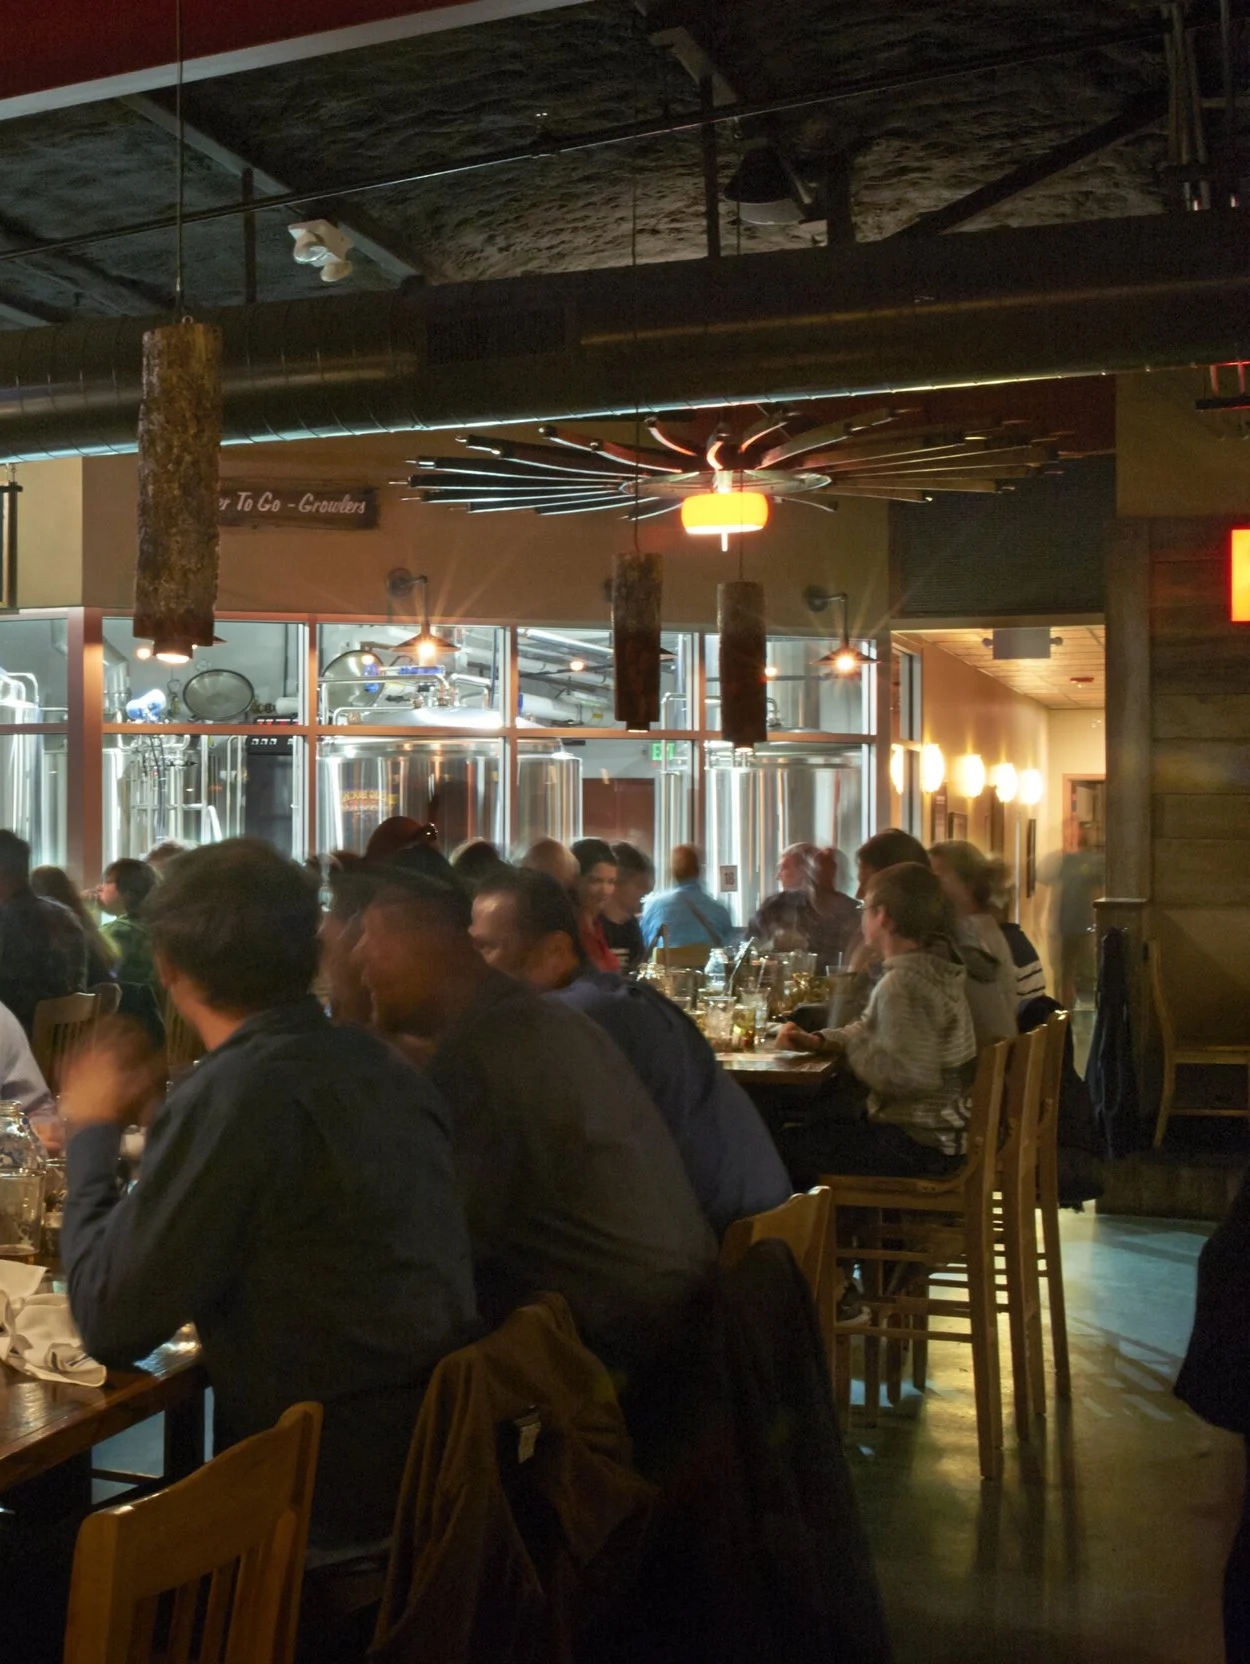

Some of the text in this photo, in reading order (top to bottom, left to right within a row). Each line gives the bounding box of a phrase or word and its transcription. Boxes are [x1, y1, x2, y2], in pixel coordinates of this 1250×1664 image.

[237, 491, 253, 512] To
[257, 491, 281, 512] Go
[298, 493, 366, 514] Growlers
